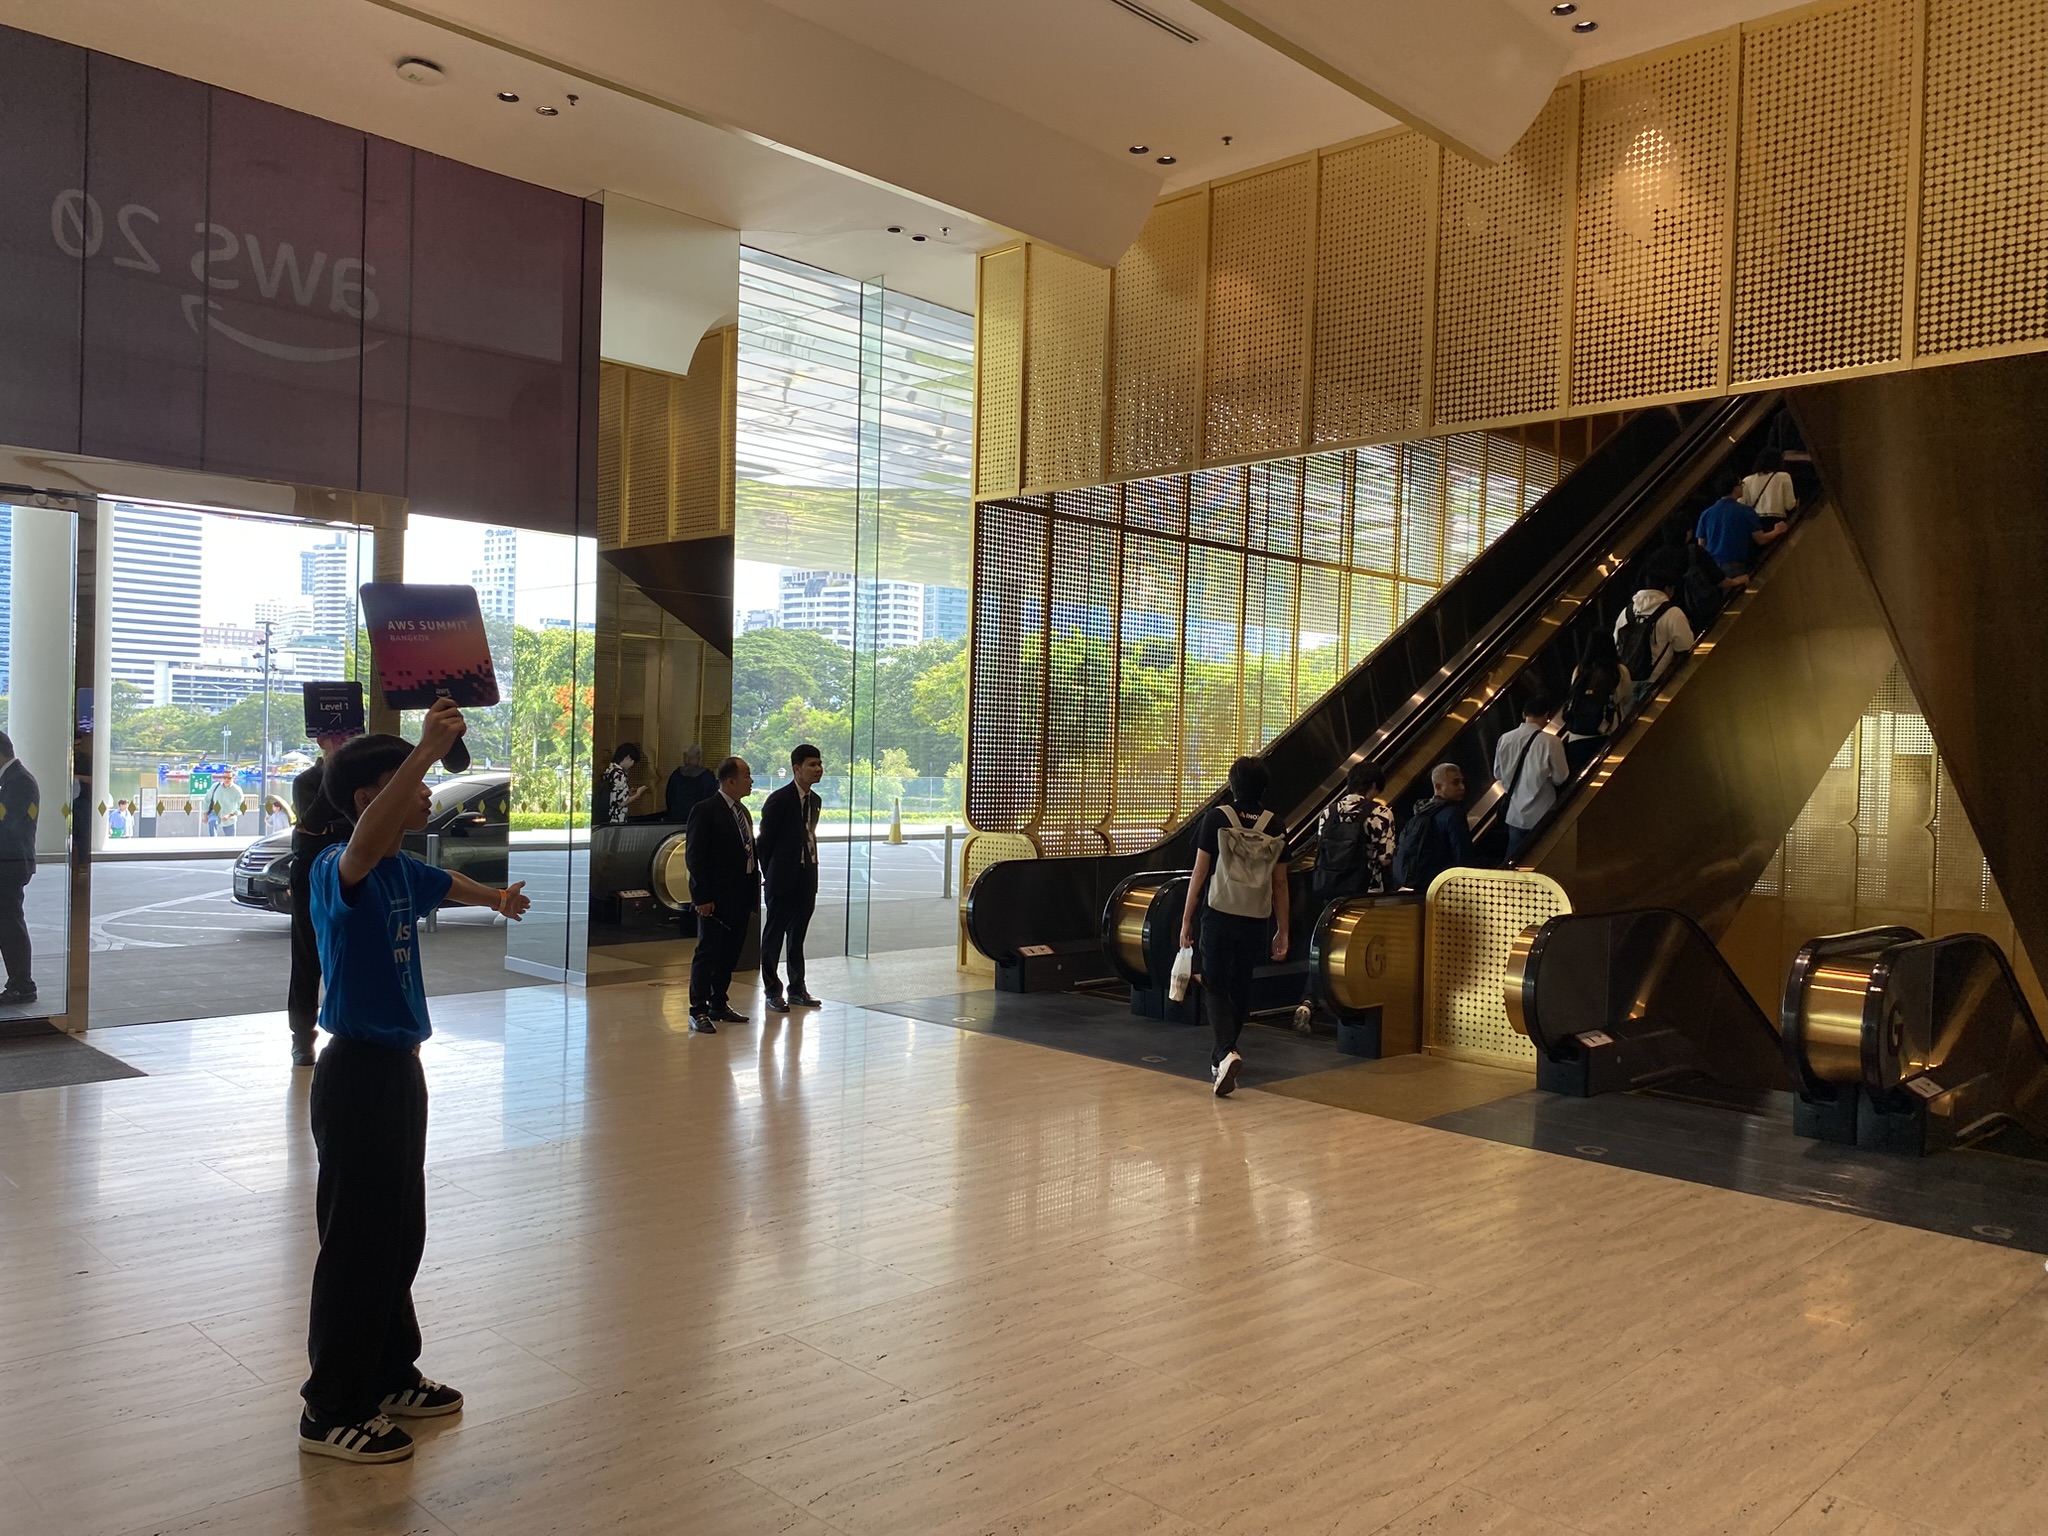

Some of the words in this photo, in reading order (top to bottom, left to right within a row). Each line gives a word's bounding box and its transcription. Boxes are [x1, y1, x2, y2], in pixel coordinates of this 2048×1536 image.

[387, 620, 415, 631] AWS
[419, 620, 469, 632] SUMMIT
[390, 634, 430, 642] BANGKOK
[320, 702, 343, 711] Level
[344, 702, 350, 711] 1
